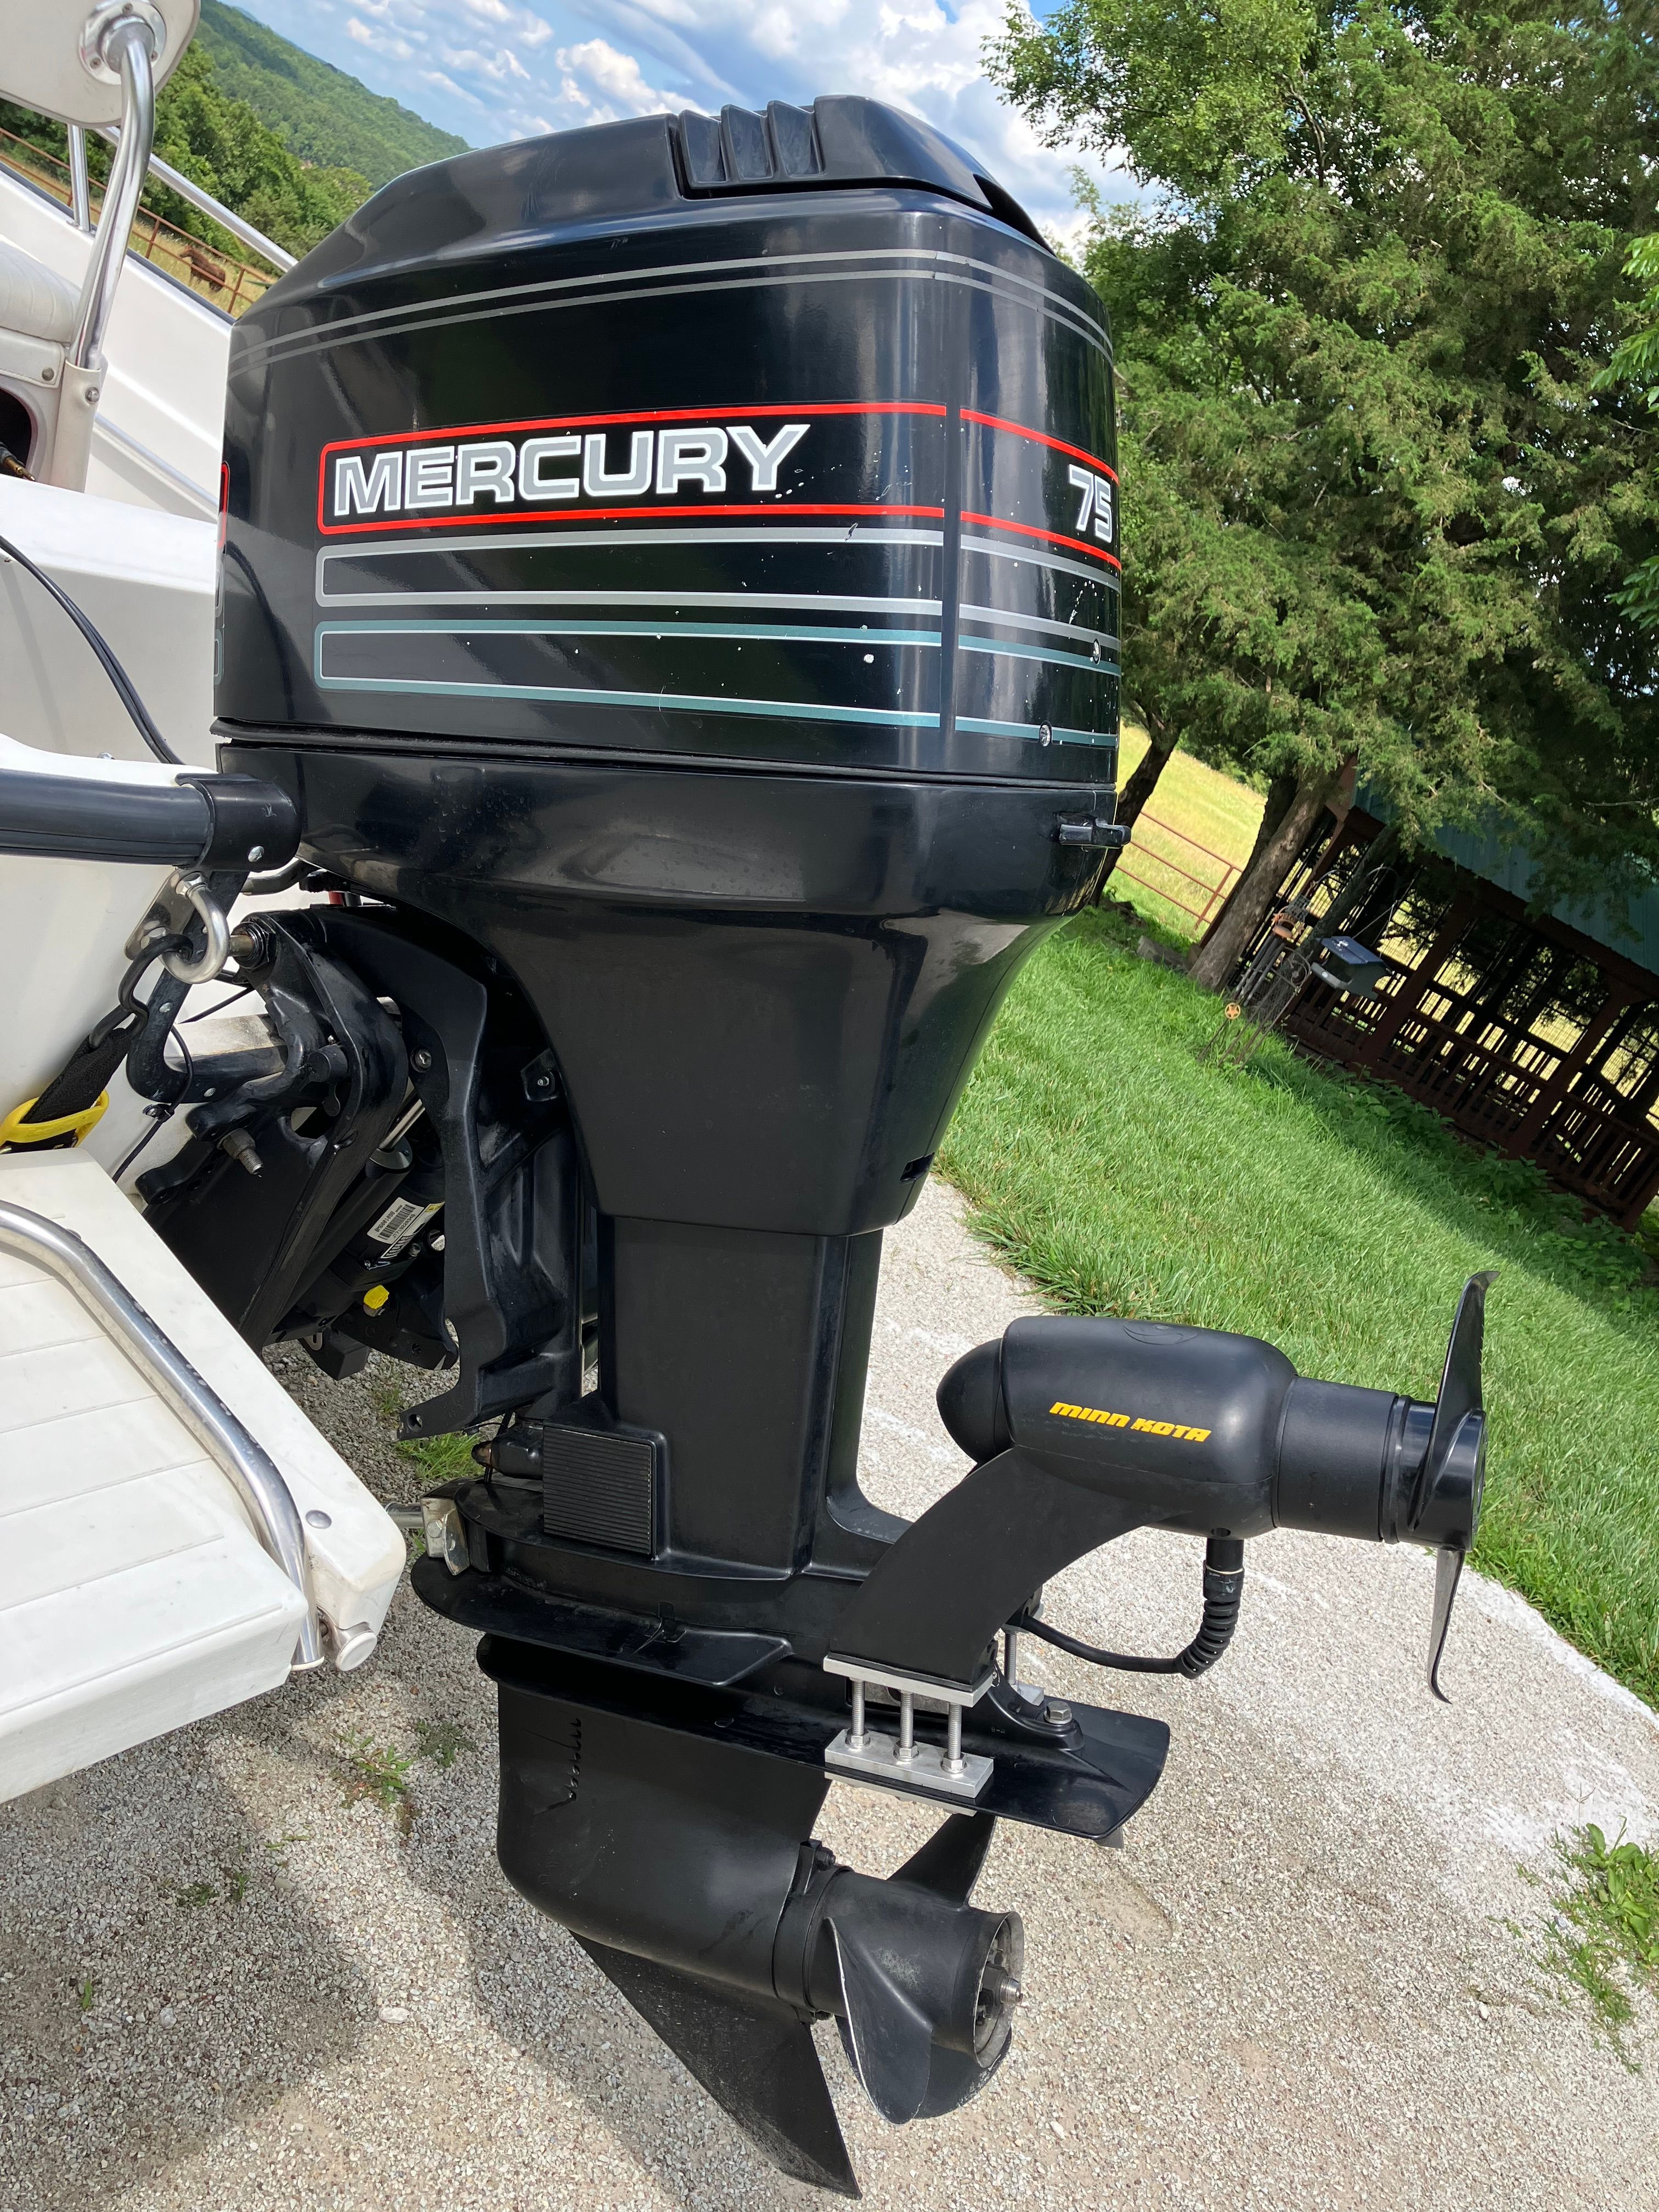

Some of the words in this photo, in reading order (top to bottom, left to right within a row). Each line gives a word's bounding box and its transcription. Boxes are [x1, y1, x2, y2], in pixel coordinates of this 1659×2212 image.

[334, 424, 811, 516] MERCURY
[1069, 464, 1113, 544] 75
[1048, 1401, 1131, 1427] MINN
[1130, 1417, 1212, 1443] KOTA
